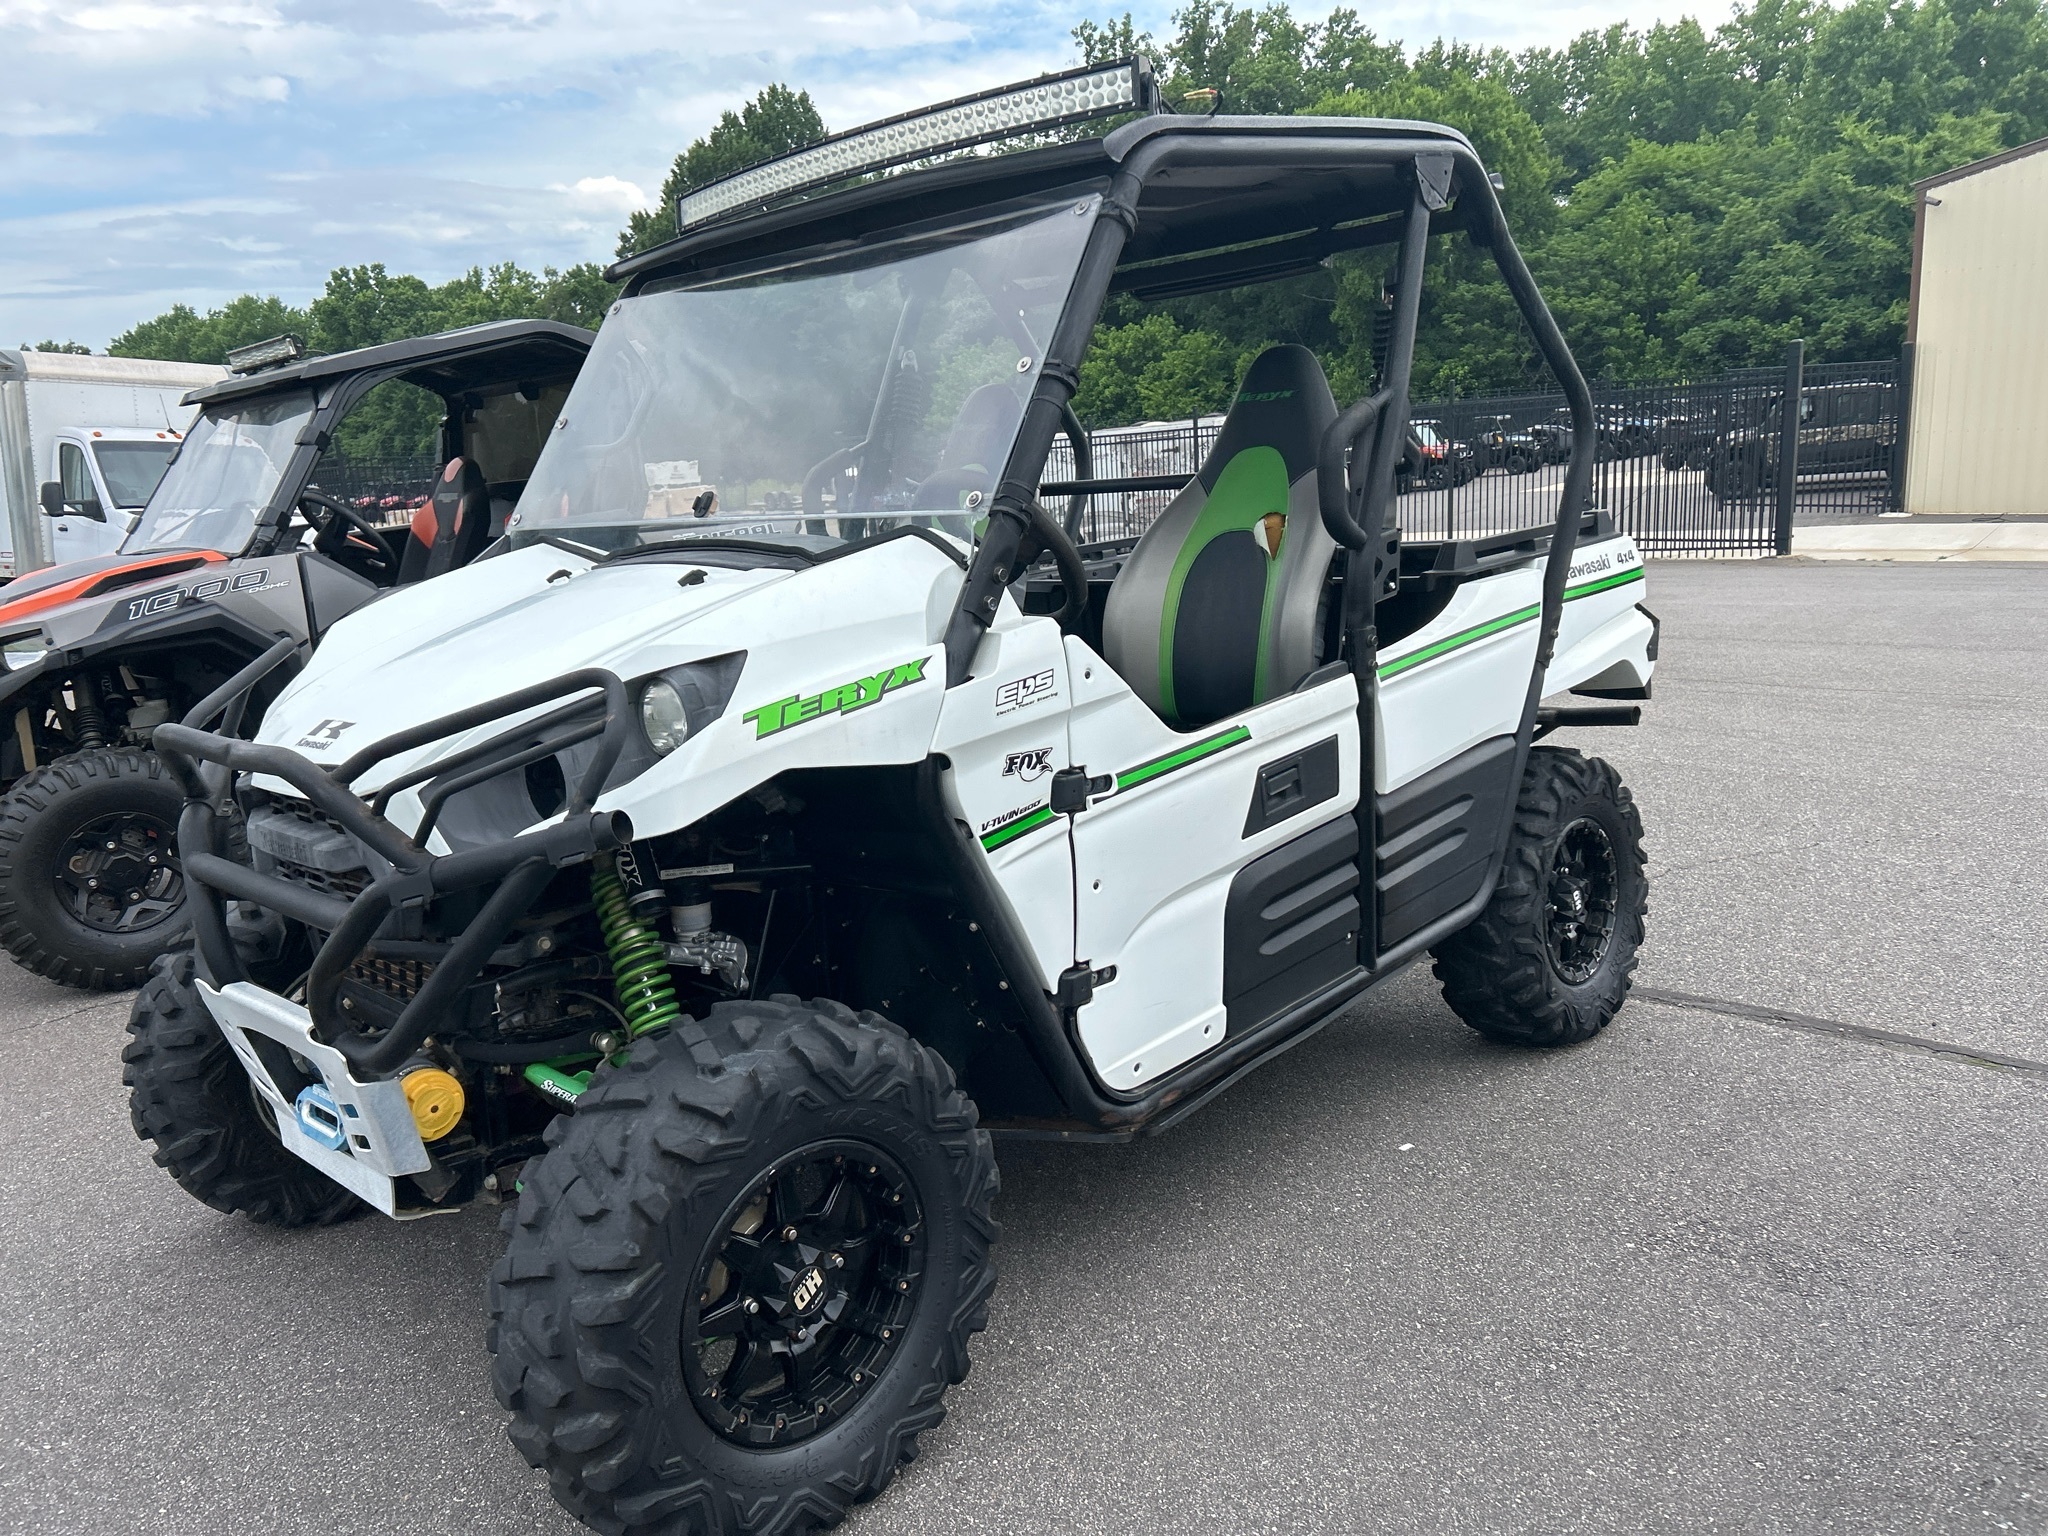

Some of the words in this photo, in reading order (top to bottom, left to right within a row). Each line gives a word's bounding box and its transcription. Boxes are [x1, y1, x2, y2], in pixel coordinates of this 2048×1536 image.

[1569, 553, 1611, 579] awasaki
[1617, 549, 1635, 564] 4x4
[128, 568, 270, 620] 1000
[248, 580, 290, 593] DOHC
[742, 655, 933, 741] TERYX
[995, 668, 1054, 707] EPS
[996, 706, 1016, 716] Electric
[1018, 699, 1035, 709] Power
[295, 737, 333, 750] Kawasaki
[1002, 747, 1053, 782] FOX
[541, 1079, 577, 1105] SUPERA
[794, 1268, 823, 1311] HD
